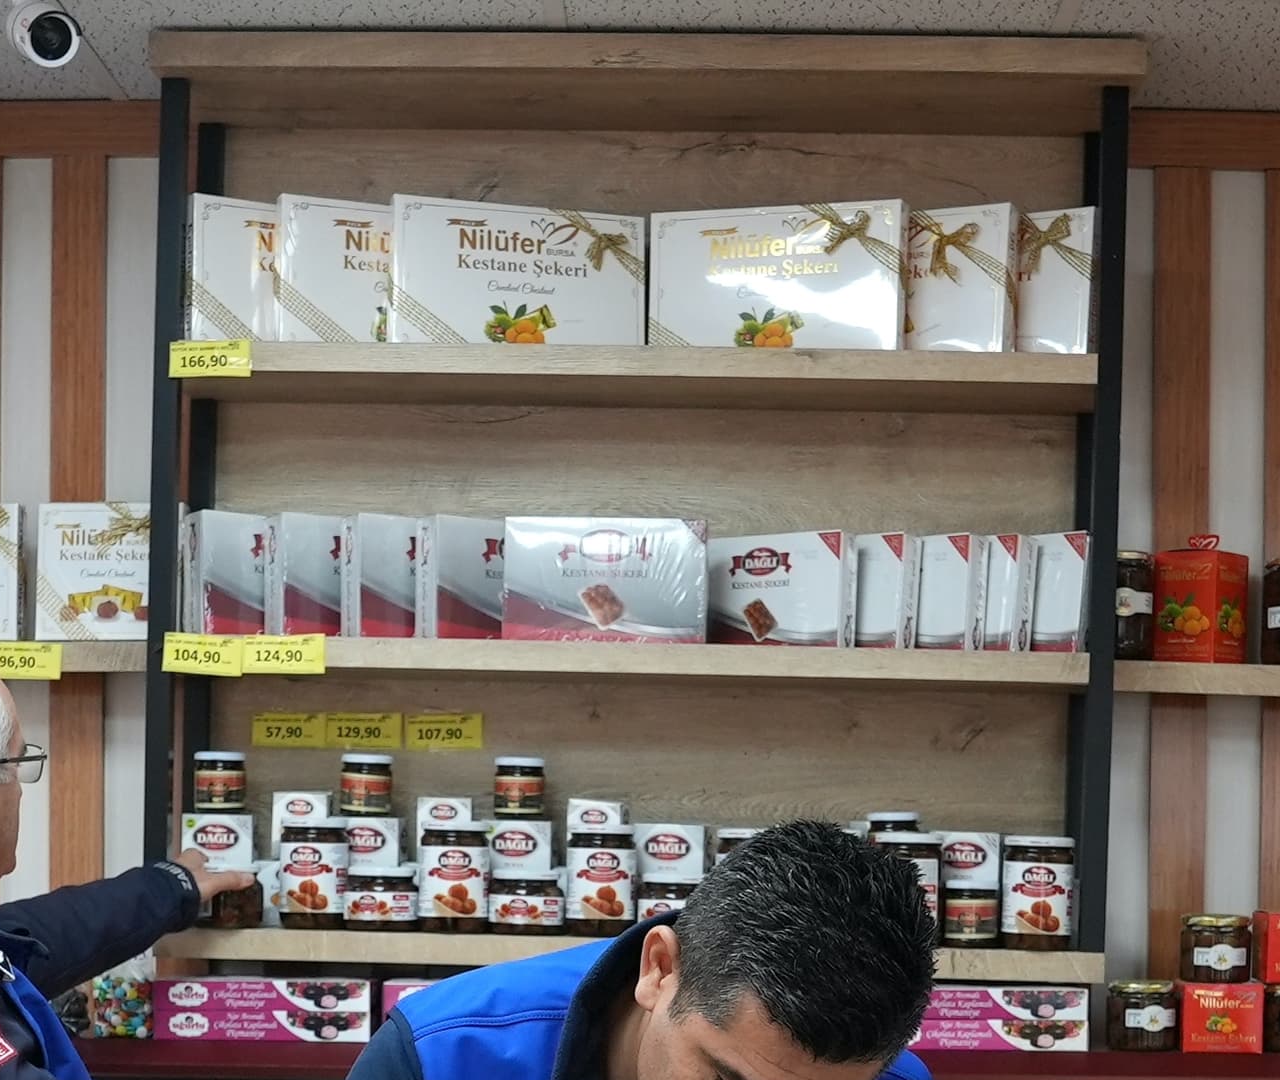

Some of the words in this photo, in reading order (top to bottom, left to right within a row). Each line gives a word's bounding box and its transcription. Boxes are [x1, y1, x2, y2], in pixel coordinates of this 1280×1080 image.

[459, 228, 546, 255] Nilüfer
[457, 254, 527, 274] Kestane
[533, 259, 588, 278] Şekeri
[180, 354, 228, 369] 166,90
[0, 655, 36, 669] 96,90
[173, 649, 221, 664] 104,90
[255, 649, 303, 663] 124,90
[265, 726, 303, 739] 57,90
[336, 726, 381, 739] 129,90
[417, 727, 463, 741] 107,90
[1199, 995, 1241, 1009] Nilüfer
